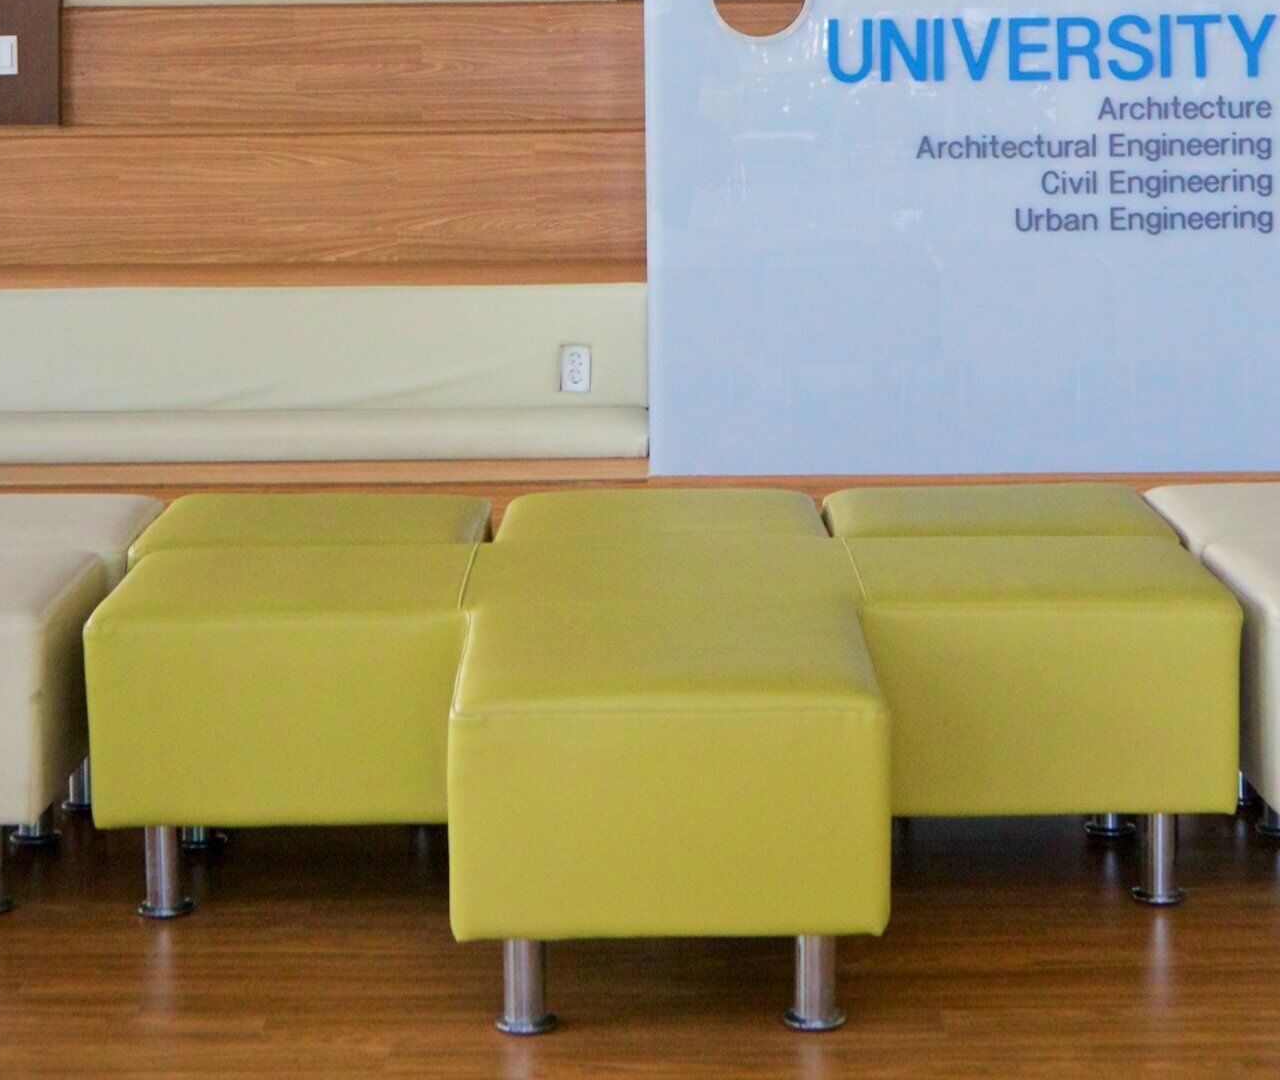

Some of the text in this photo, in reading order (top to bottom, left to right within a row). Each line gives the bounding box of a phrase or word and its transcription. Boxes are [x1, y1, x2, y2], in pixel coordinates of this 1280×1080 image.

[825, 13, 1277, 85] UNIVERSITY
[1097, 95, 1273, 121] Architecture
[916, 132, 1273, 163] Architectural Engineering
[1041, 168, 1274, 199] Civil Engineering
[1014, 204, 1275, 236] Urban Engineering
